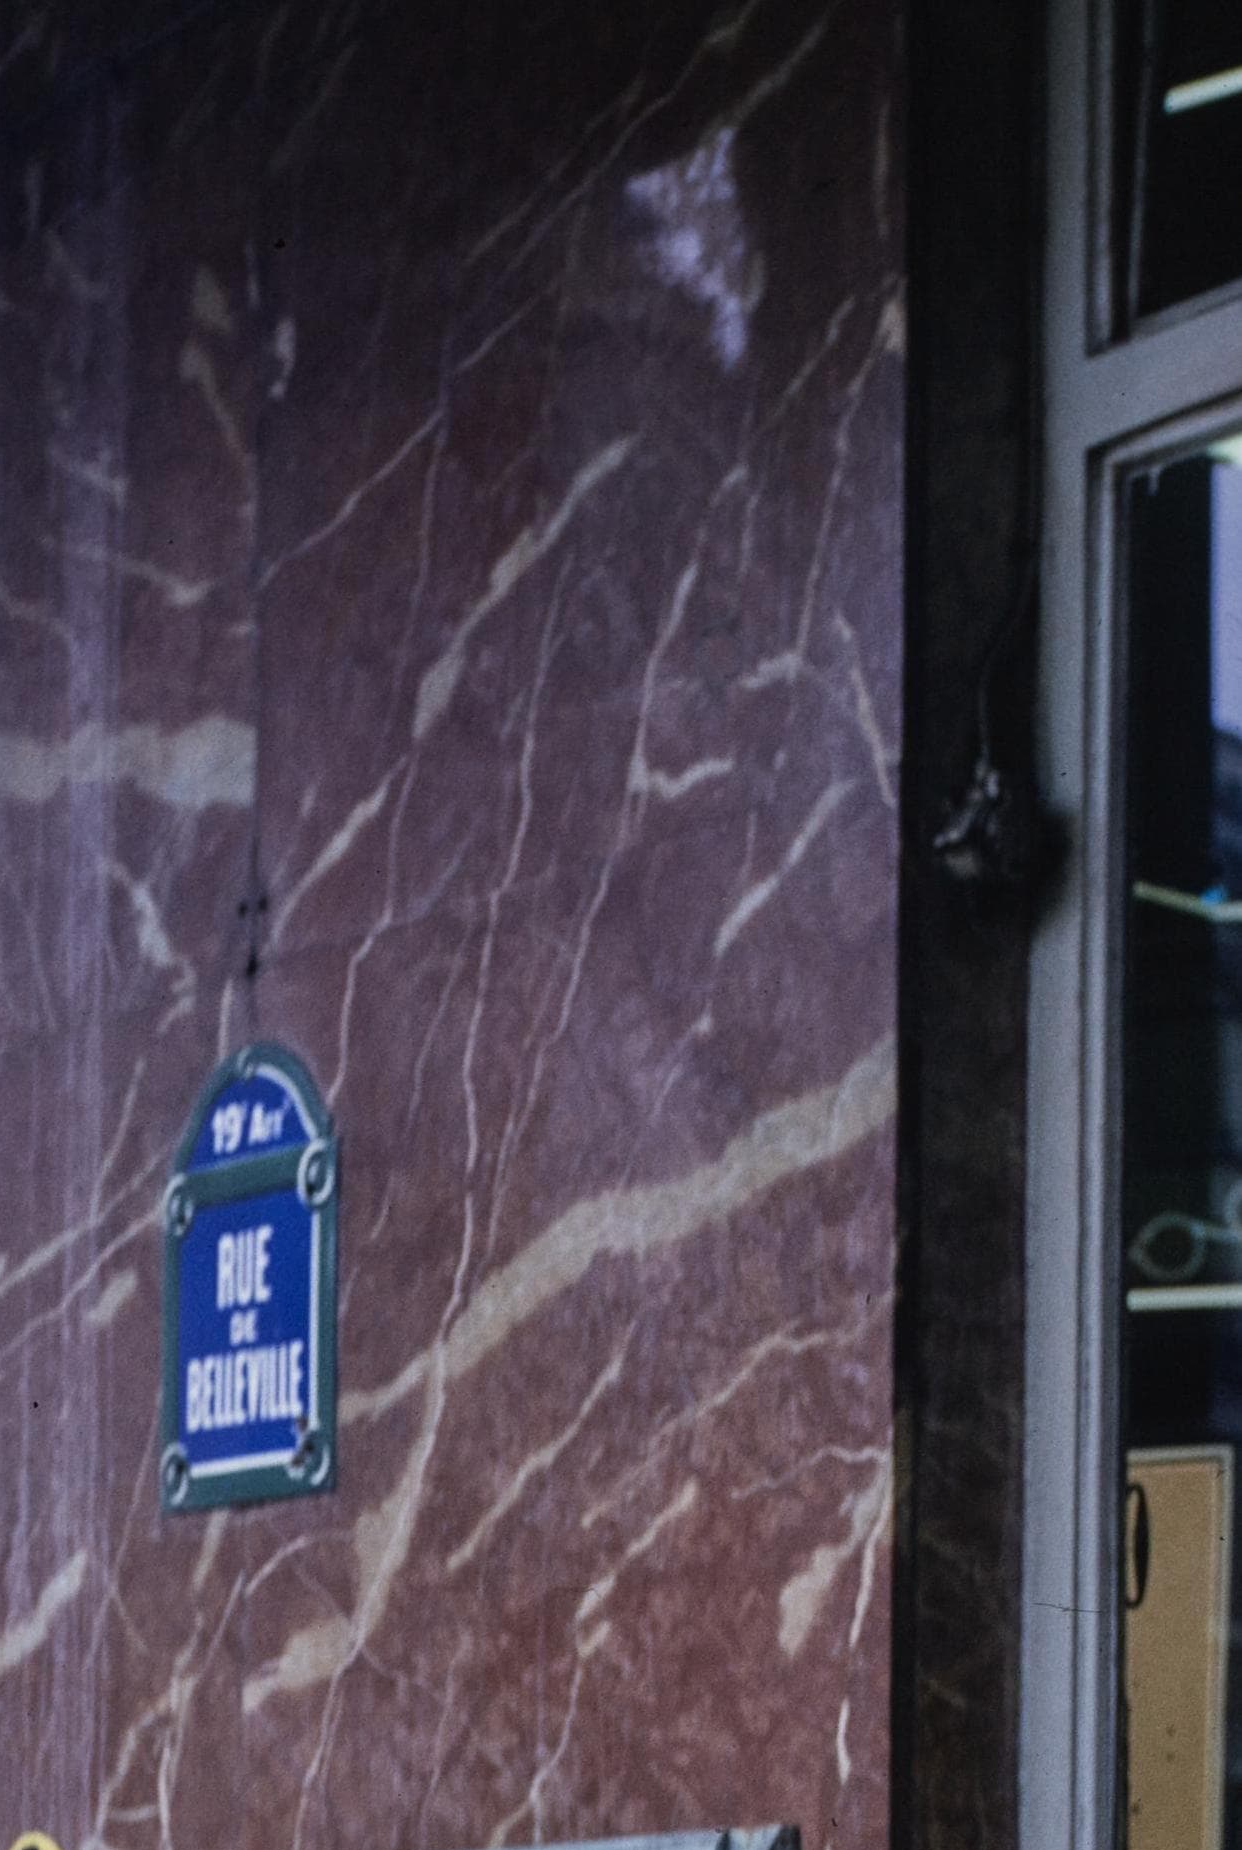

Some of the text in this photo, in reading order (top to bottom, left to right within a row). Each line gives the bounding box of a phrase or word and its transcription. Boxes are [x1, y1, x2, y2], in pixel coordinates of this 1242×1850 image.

[217, 1225, 273, 1309] RUE
[231, 1311, 257, 1345] DE
[187, 1342, 303, 1432] BELLEVILLE
